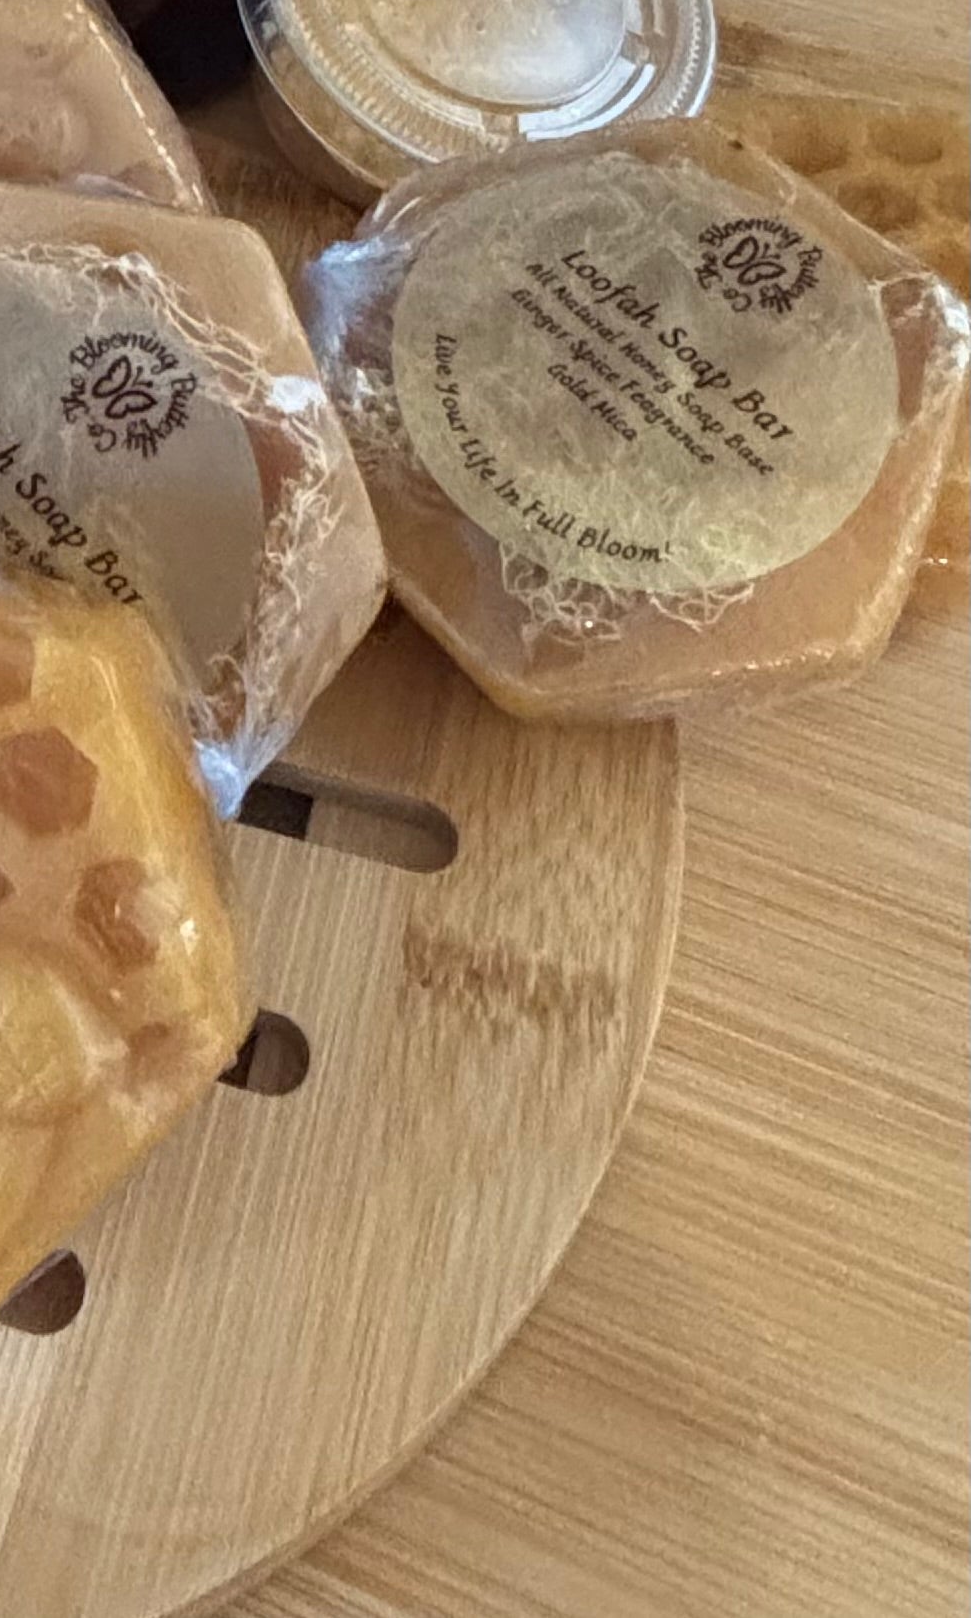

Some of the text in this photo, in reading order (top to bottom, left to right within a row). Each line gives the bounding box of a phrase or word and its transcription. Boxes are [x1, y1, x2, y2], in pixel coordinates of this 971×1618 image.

[69, 331, 180, 375] Blooming
[510, 287, 571, 341] Ginger
[569, 338, 622, 384] Spice
[525, 261, 776, 476] All Natural Honey Soap Base
[560, 249, 795, 440] Loofah Soap Bar
[434, 333, 458, 376] Live
[458, 437, 498, 481] Life
[493, 478, 522, 507] In
[521, 498, 577, 541] Full
[576, 525, 674, 564] Bloom!
[546, 363, 638, 443] Gold Mica
[15, 472, 88, 548] Soap
[84, 549, 144, 605] Bar
